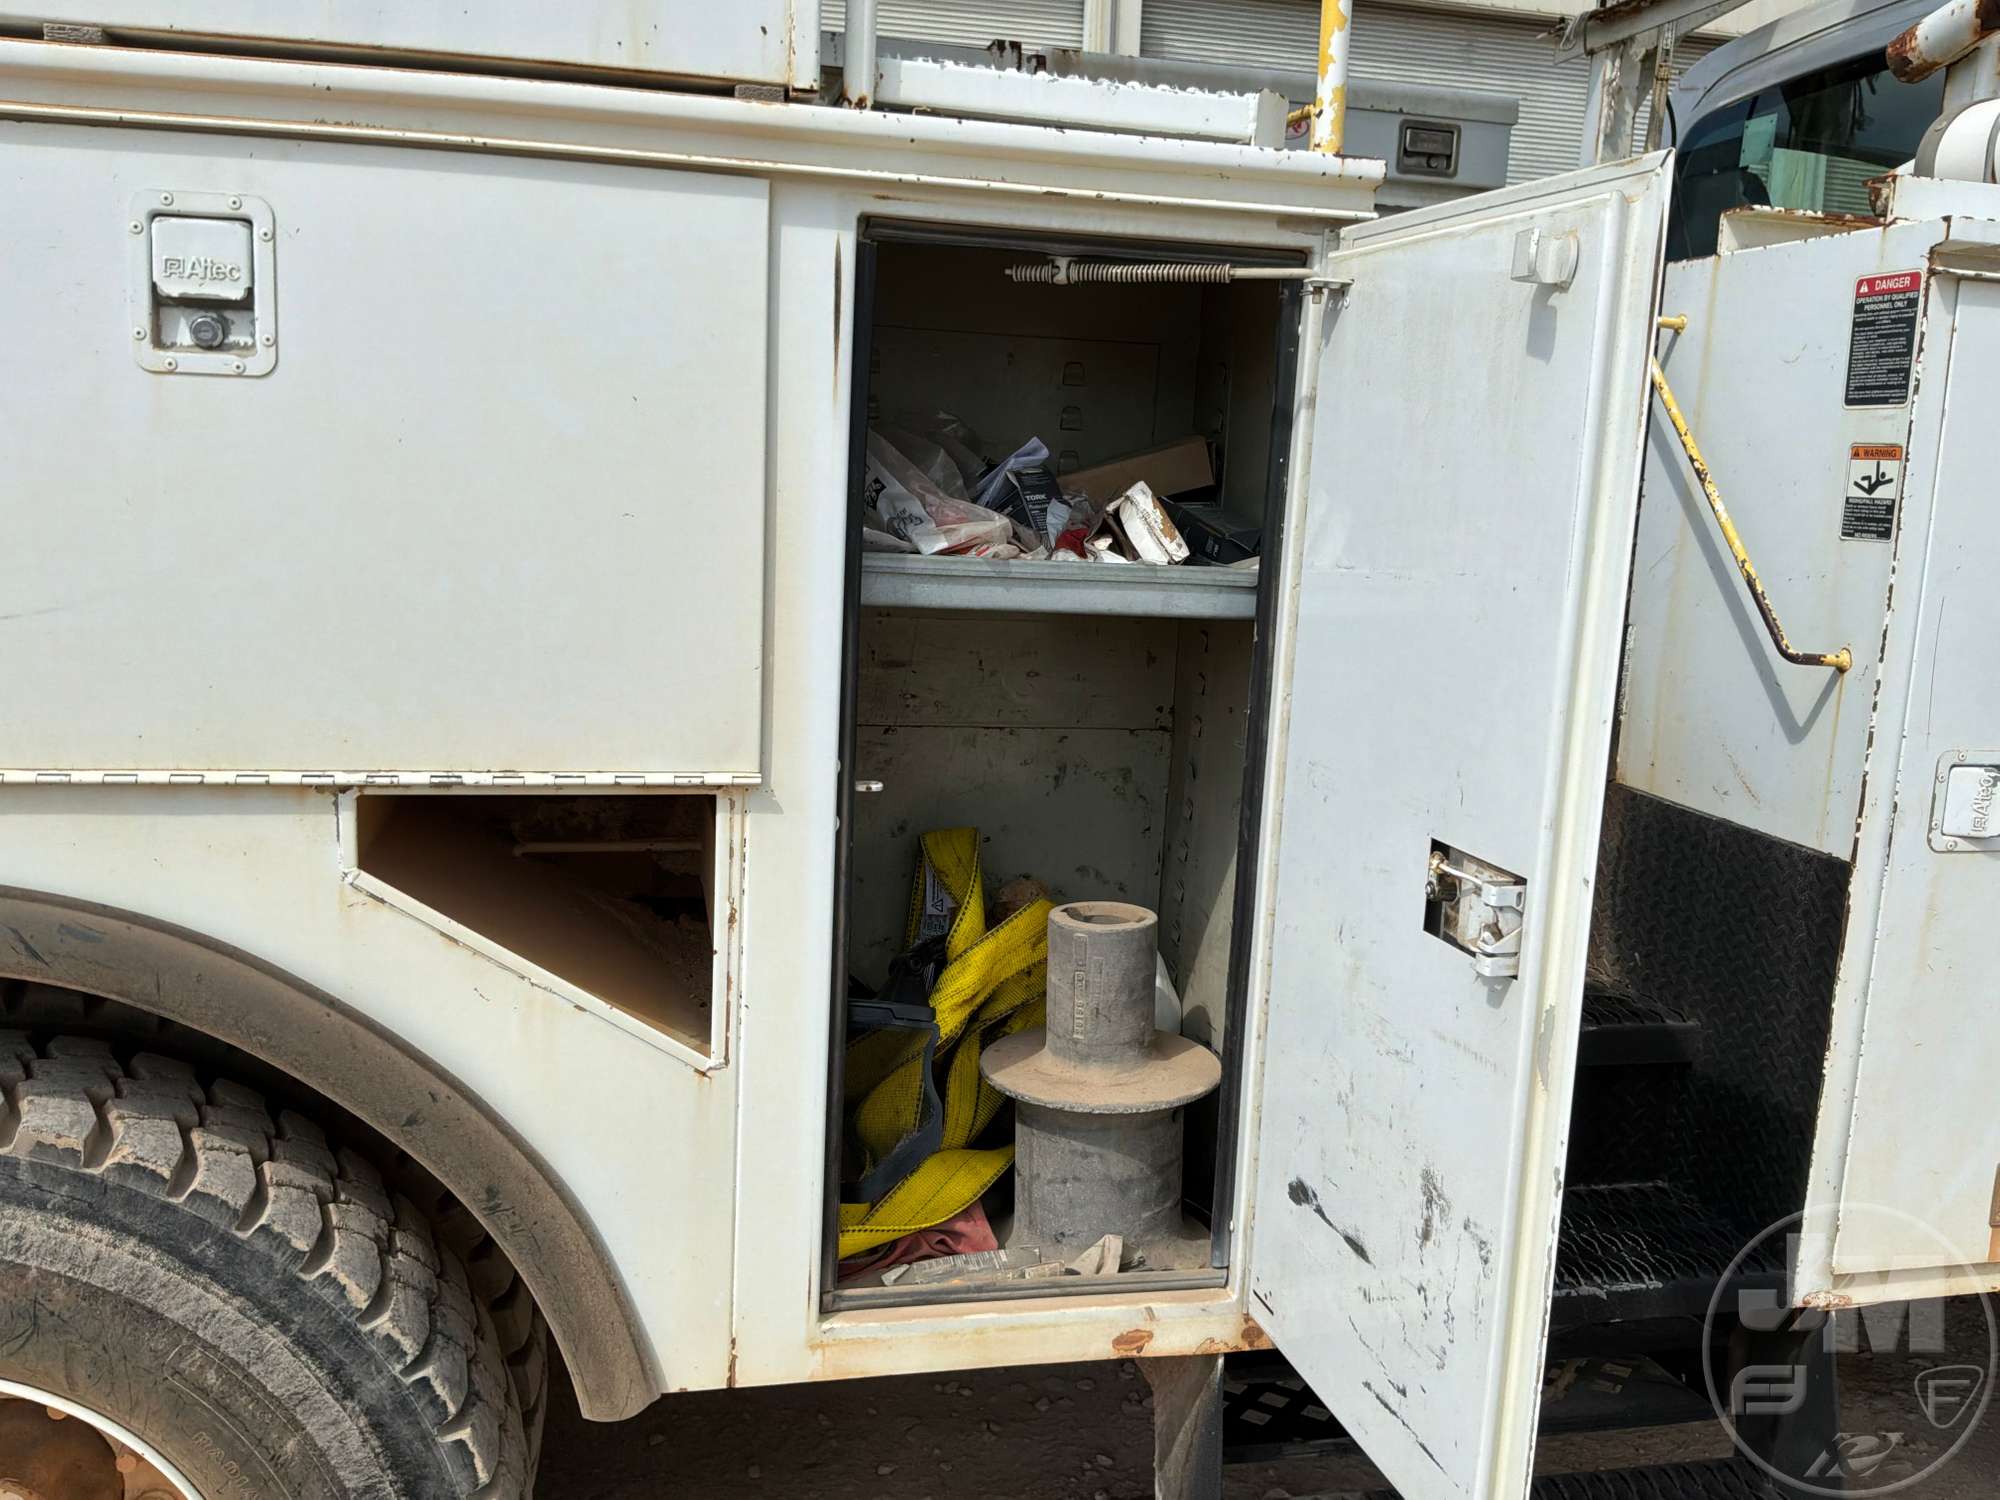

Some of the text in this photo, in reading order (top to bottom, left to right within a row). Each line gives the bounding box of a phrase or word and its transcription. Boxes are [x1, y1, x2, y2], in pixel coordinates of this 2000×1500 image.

[1875, 277, 1911, 290] DANGER
[1864, 303, 1893, 311] PERSONNEL
[1863, 449, 1897, 458] WARNING
[1971, 774, 1994, 817] Altec
